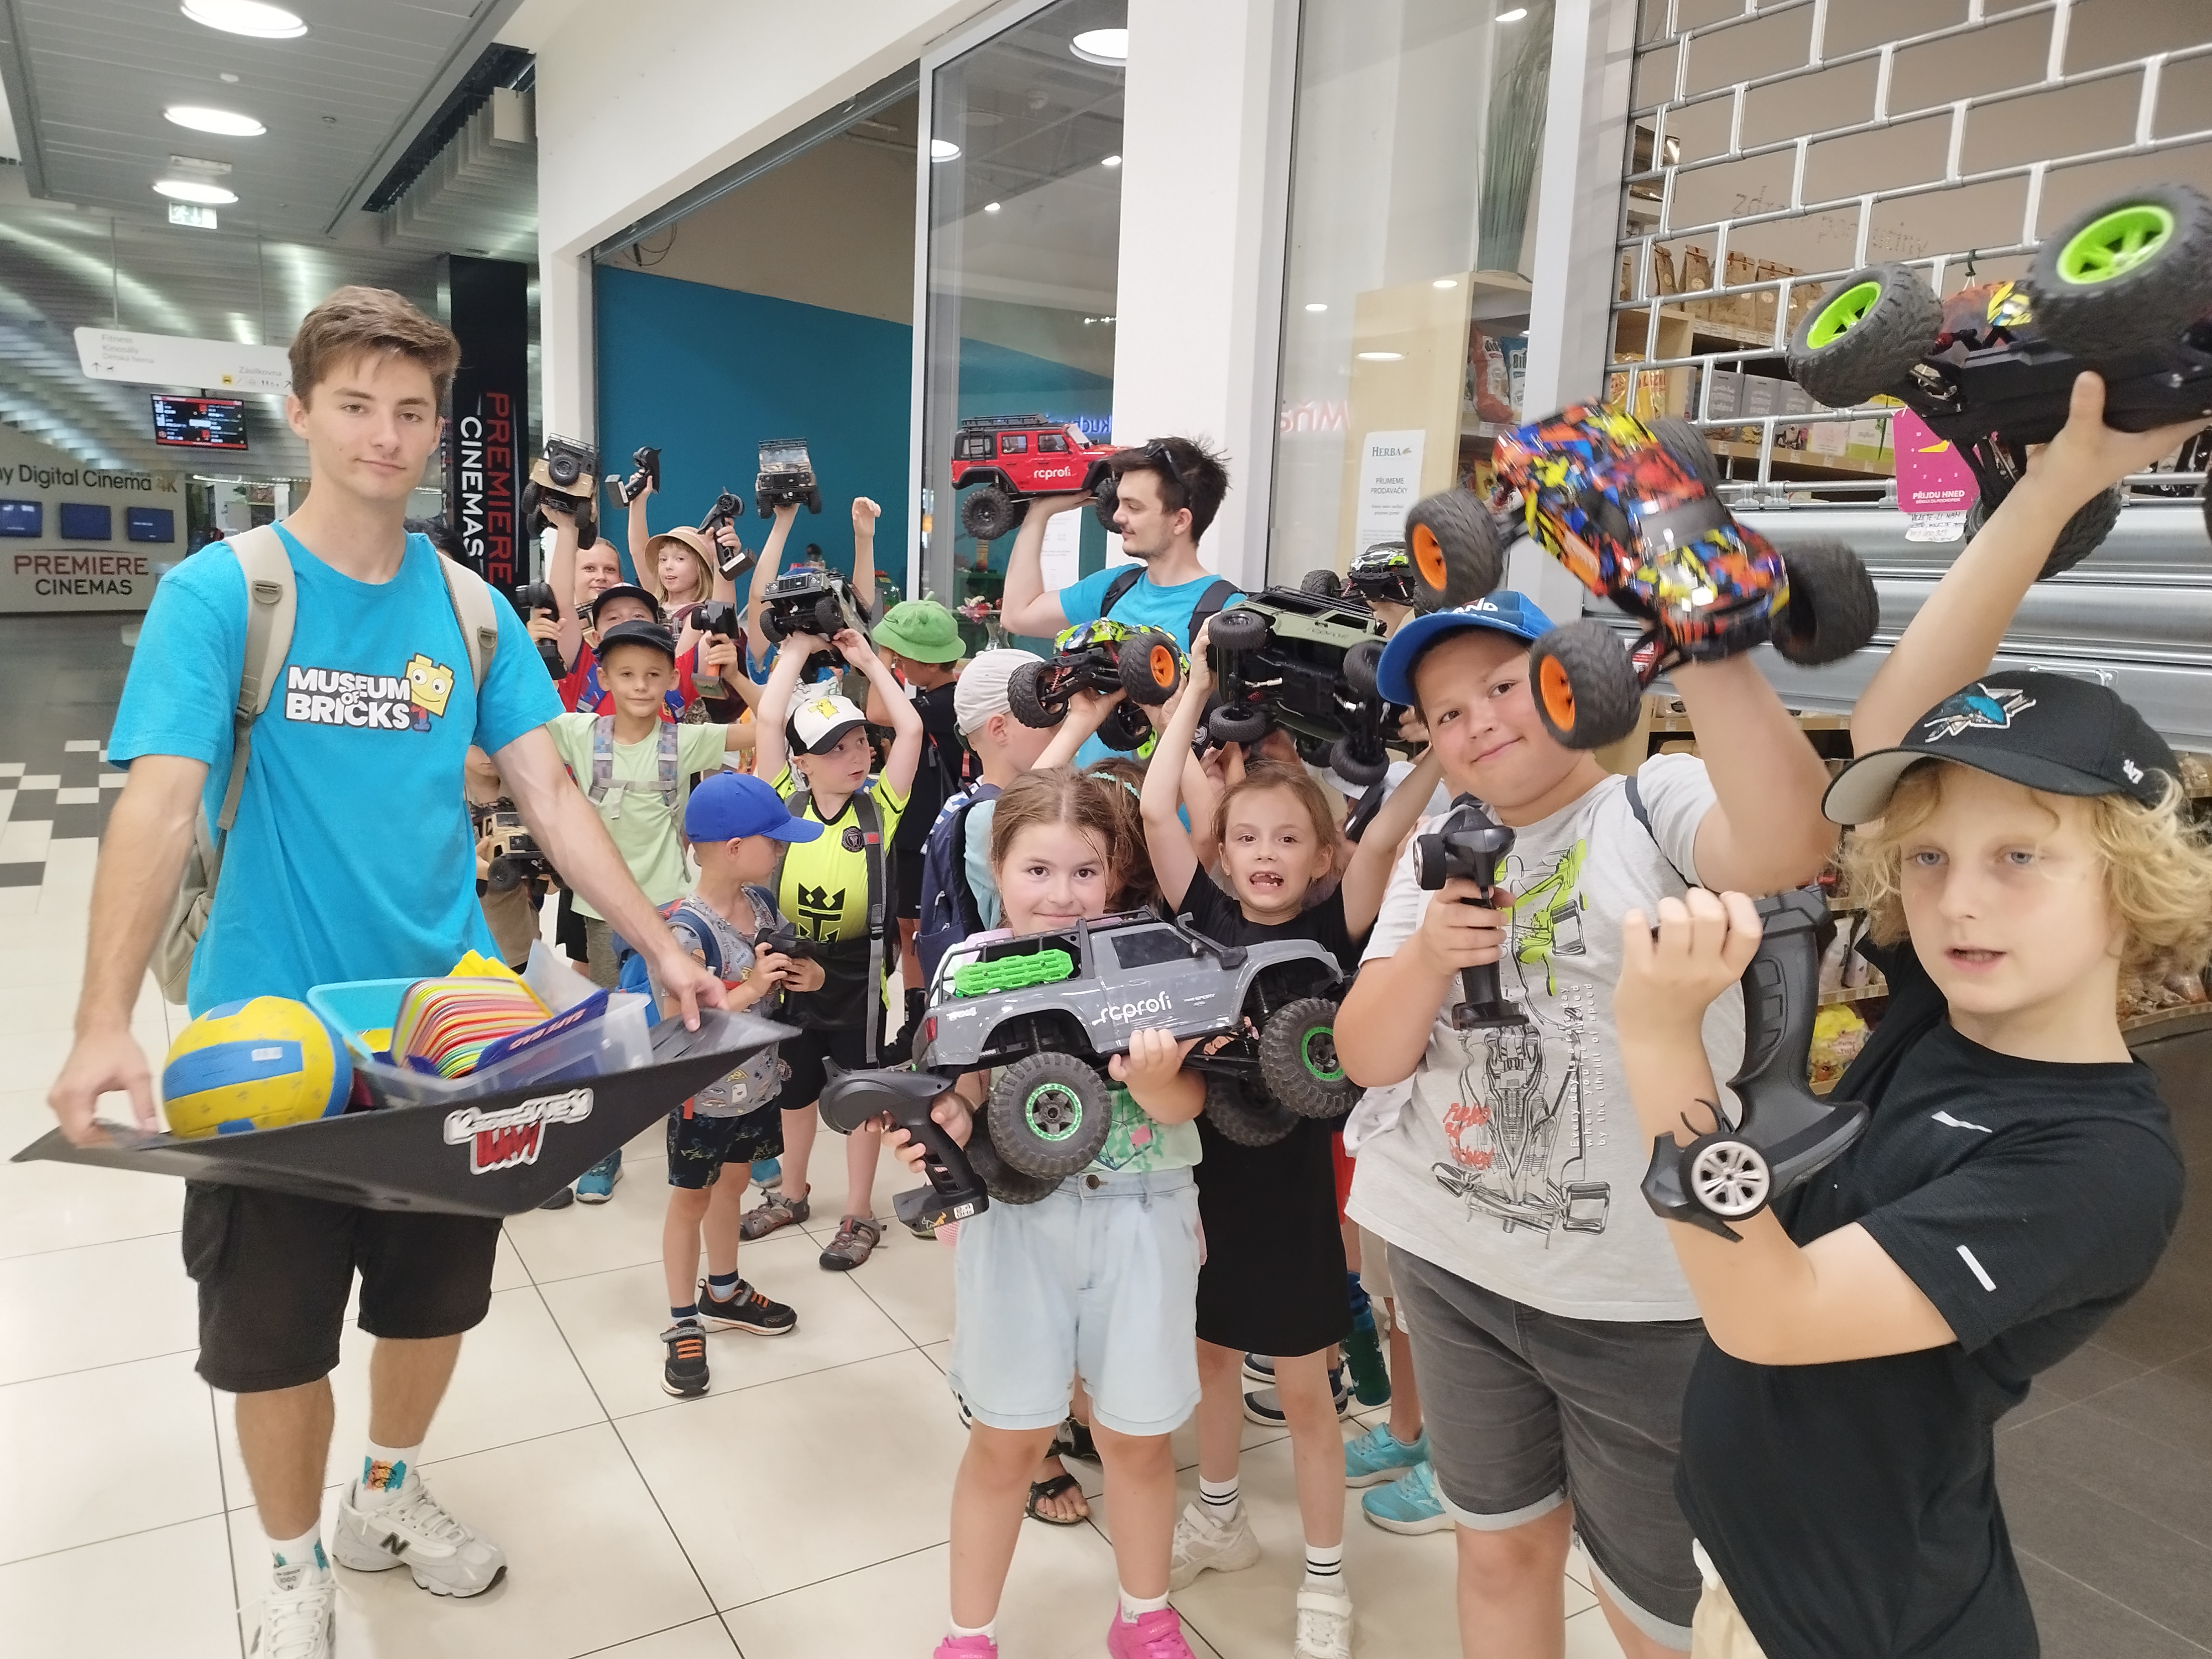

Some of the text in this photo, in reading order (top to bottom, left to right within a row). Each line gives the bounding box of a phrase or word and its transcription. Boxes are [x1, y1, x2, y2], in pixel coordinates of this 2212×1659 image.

[101, 334, 133, 343] Fitness
[238, 366, 282, 377] Zásilkovna
[1372, 446, 1401, 457] HERBA
[19, 465, 79, 489] Digital
[83, 469, 152, 491] Cinema
[1034, 466, 1072, 481] rcprofi
[460, 416, 484, 557] CINEMAS
[487, 392, 512, 585] PREMIERE
[1912, 490, 1965, 500] PŘIJDU HNED
[14, 555, 149, 576] PREMIERE
[35, 579, 133, 596] CINEMAS
[288, 666, 410, 701] MUSEUM
[341, 691, 361, 706] OF
[286, 692, 410, 729] BRICKS
[1100, 990, 1172, 1024] rcprofi
[1560, 987, 1569, 1009] day
[1589, 1031, 1599, 1044] of
[1567, 1060, 1575, 1072] is
[1593, 1052, 1604, 1091] thrill
[1568, 1079, 1579, 1102] day
[1597, 1100, 1605, 1123] the
[1571, 1109, 1580, 1148] Every
[1583, 1107, 1593, 1147] when
[1598, 1132, 1609, 1147] by
